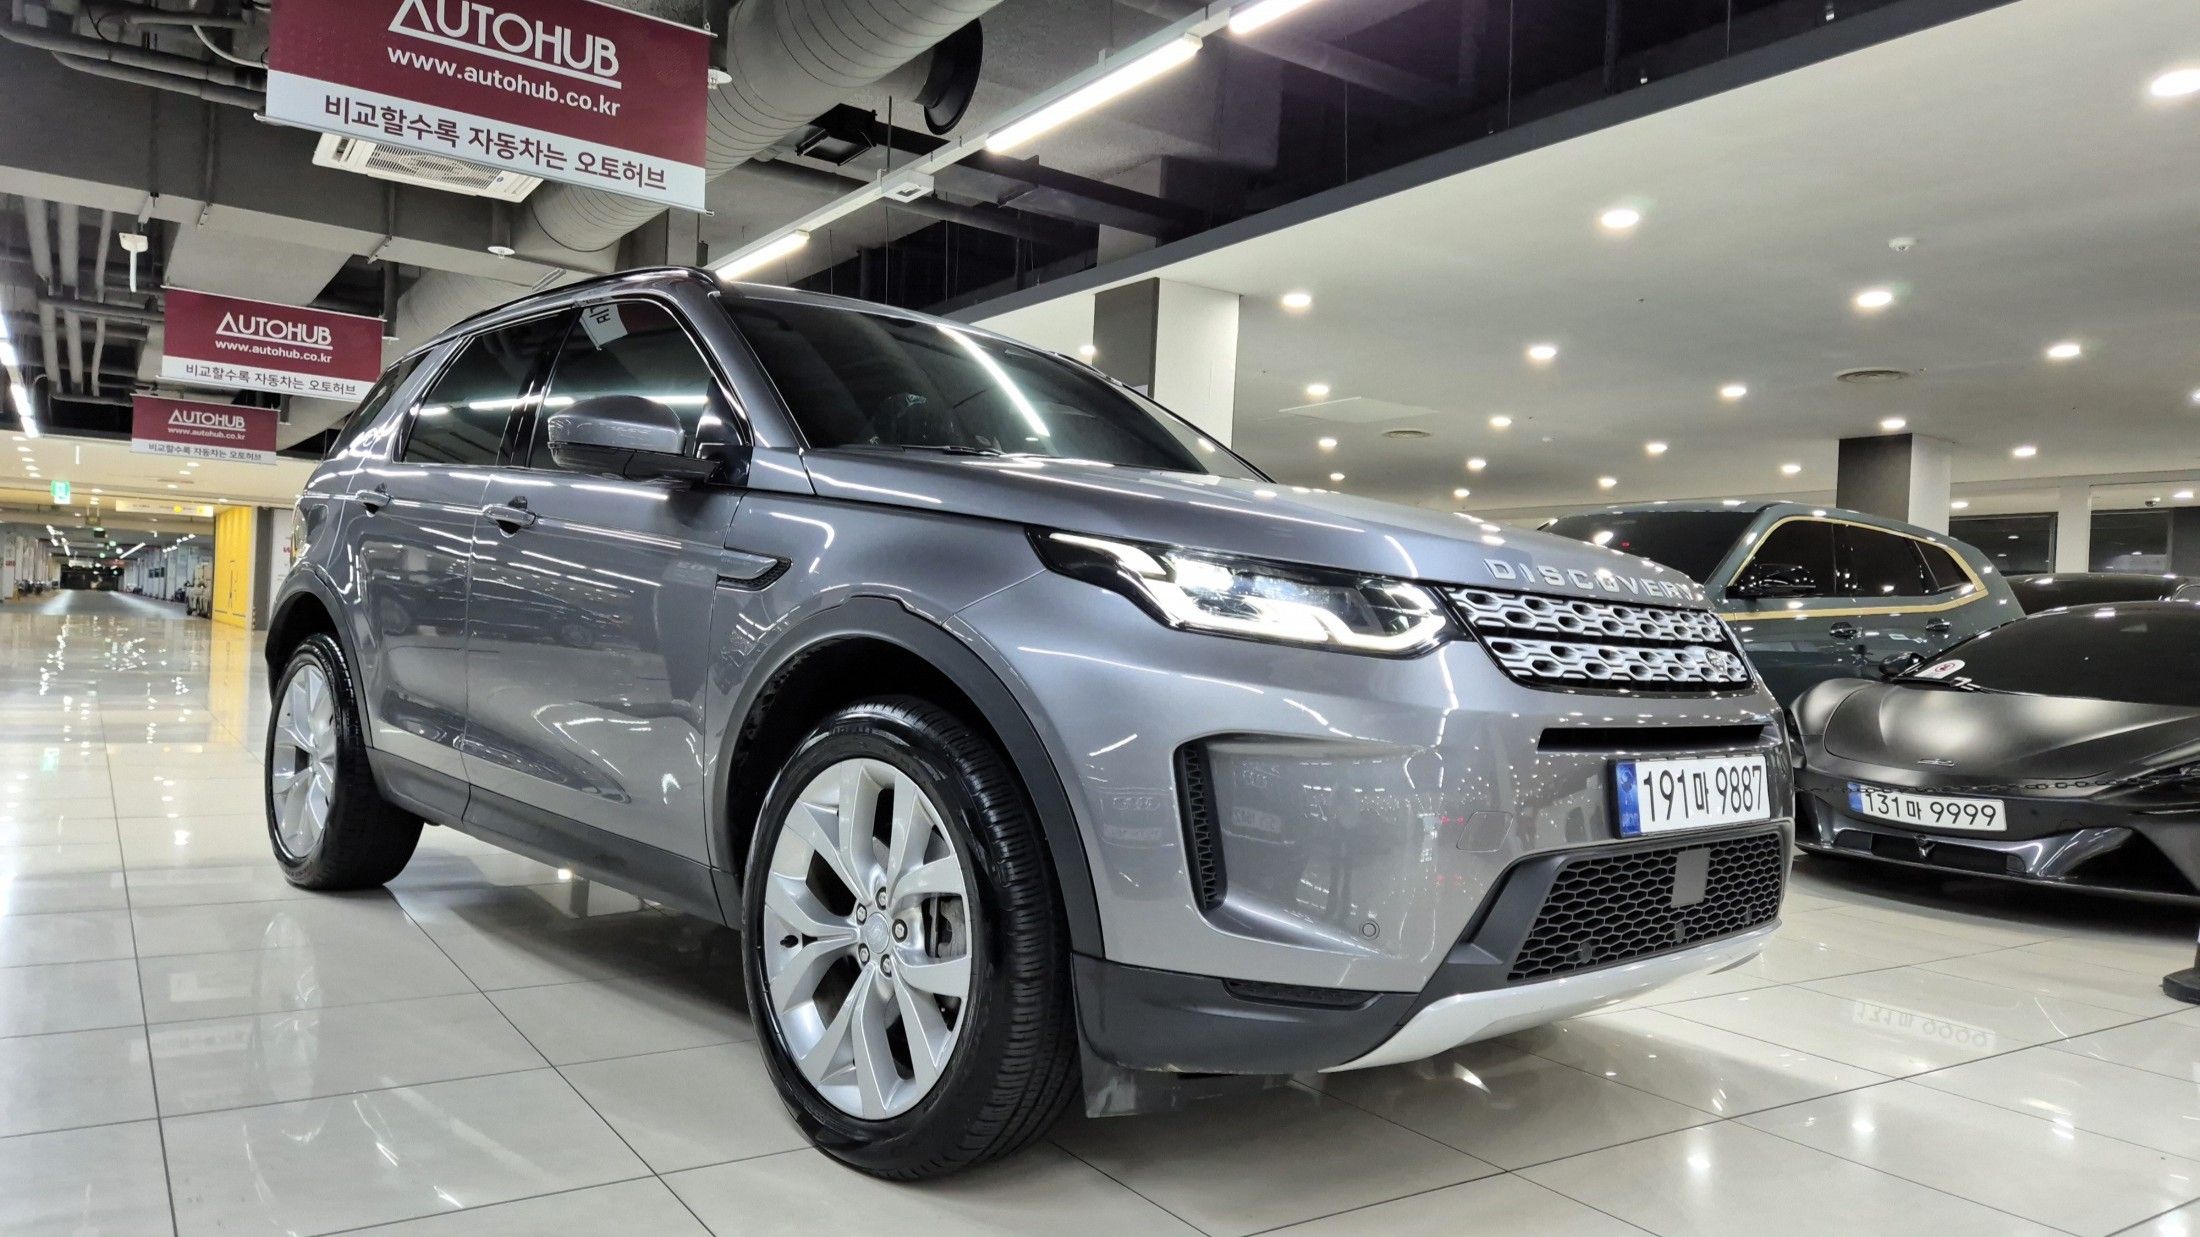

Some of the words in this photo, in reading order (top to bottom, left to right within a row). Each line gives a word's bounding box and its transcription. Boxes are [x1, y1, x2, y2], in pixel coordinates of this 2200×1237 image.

[388, 0, 620, 80] AUTOHUB
[387, 46, 621, 117] www.autohub.co.kr
[325, 94, 460, 148] 비교할수록
[468, 127, 567, 171] 자동차는
[575, 151, 667, 191] 오토허브
[216, 312, 332, 347] AUTOHUB
[215, 340, 333, 363] www.autohub.co.kr
[186, 363, 250, 383] 비교할수록
[255, 373, 304, 390] 자동차는
[308, 379, 357, 395] 오토허브
[168, 409, 245, 429] AUTOHUB
[168, 427, 246, 441] www.autohub.co.kr
[149, 443, 191, 456] 비교할수록
[194, 448, 226, 458] 자동차는
[229, 451, 262, 461] 오토허브
[1482, 558, 1703, 601] DISCOVERY
[1643, 769, 1710, 822] 191마
[1715, 765, 1762, 815] 9887
[1865, 792, 1922, 820] 131마
[1930, 801, 1997, 827] 9999
